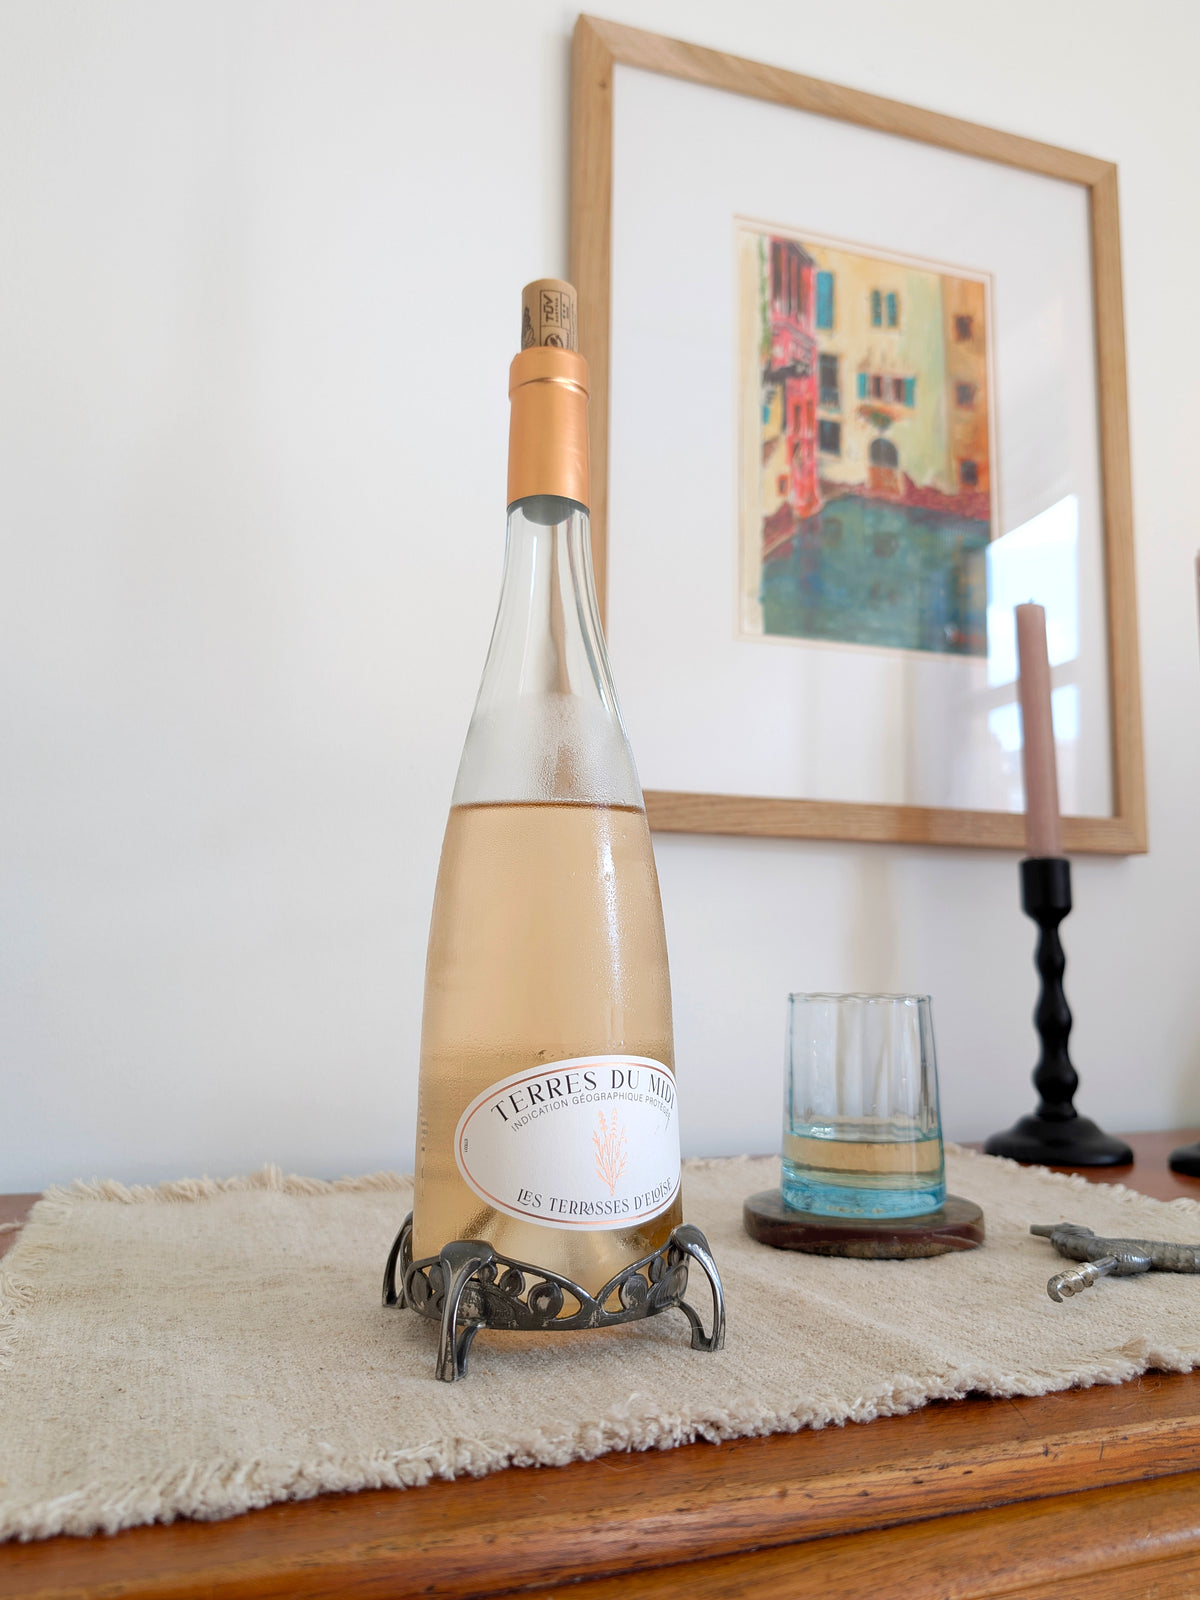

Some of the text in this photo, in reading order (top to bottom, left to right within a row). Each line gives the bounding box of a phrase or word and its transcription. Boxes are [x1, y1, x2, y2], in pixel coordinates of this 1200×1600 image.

[543, 294, 554, 322] TÜV
[490, 1069, 675, 1123] TERRES DU MIDI
[511, 1100, 569, 1133] INDICATION
[572, 1092, 643, 1105] GÉOGRAPHIQUE
[516, 1188, 543, 1208] LES
[549, 1197, 630, 1216] TERRASSES
